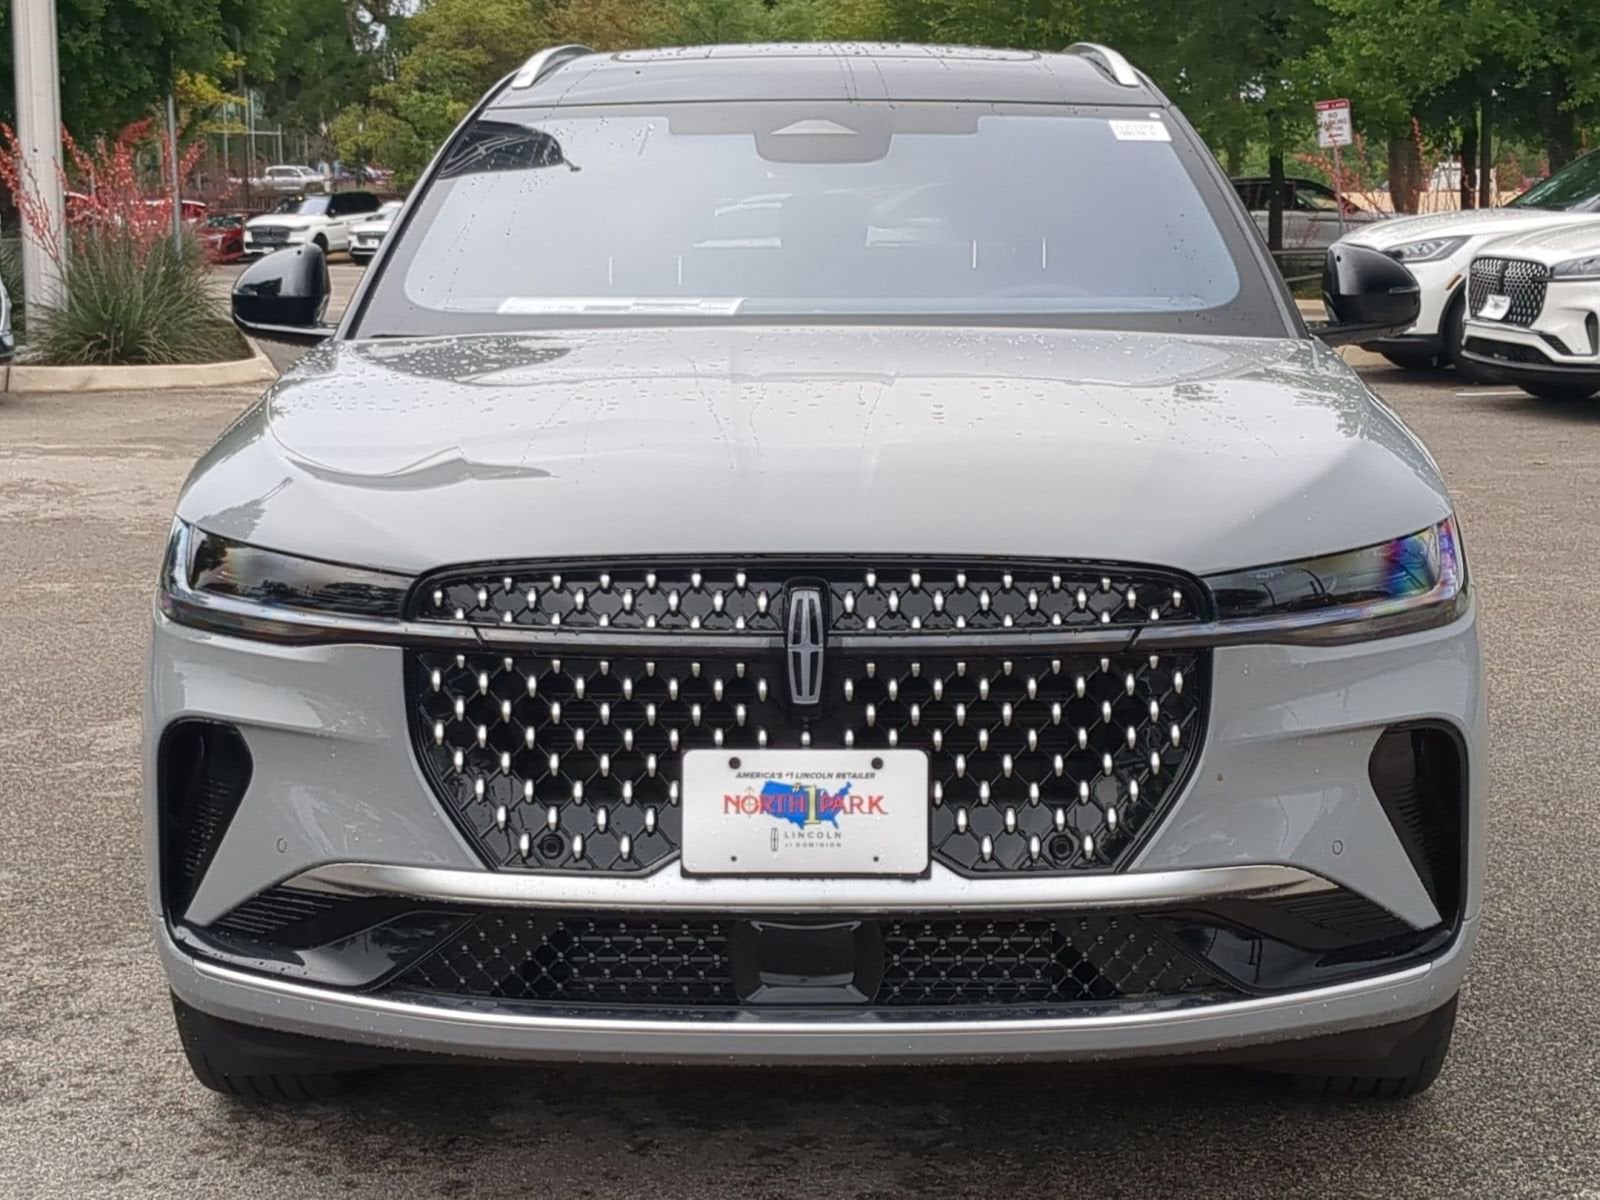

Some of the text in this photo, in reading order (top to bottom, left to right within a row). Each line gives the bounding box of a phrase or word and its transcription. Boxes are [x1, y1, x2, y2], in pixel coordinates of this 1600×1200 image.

[735, 771, 784, 780] AMERICA'S
[795, 771, 833, 780] LINCOLN
[835, 771, 876, 780] RETAILER
[723, 794, 889, 815] NORTH PARK
[784, 831, 842, 839] LINCOLN
